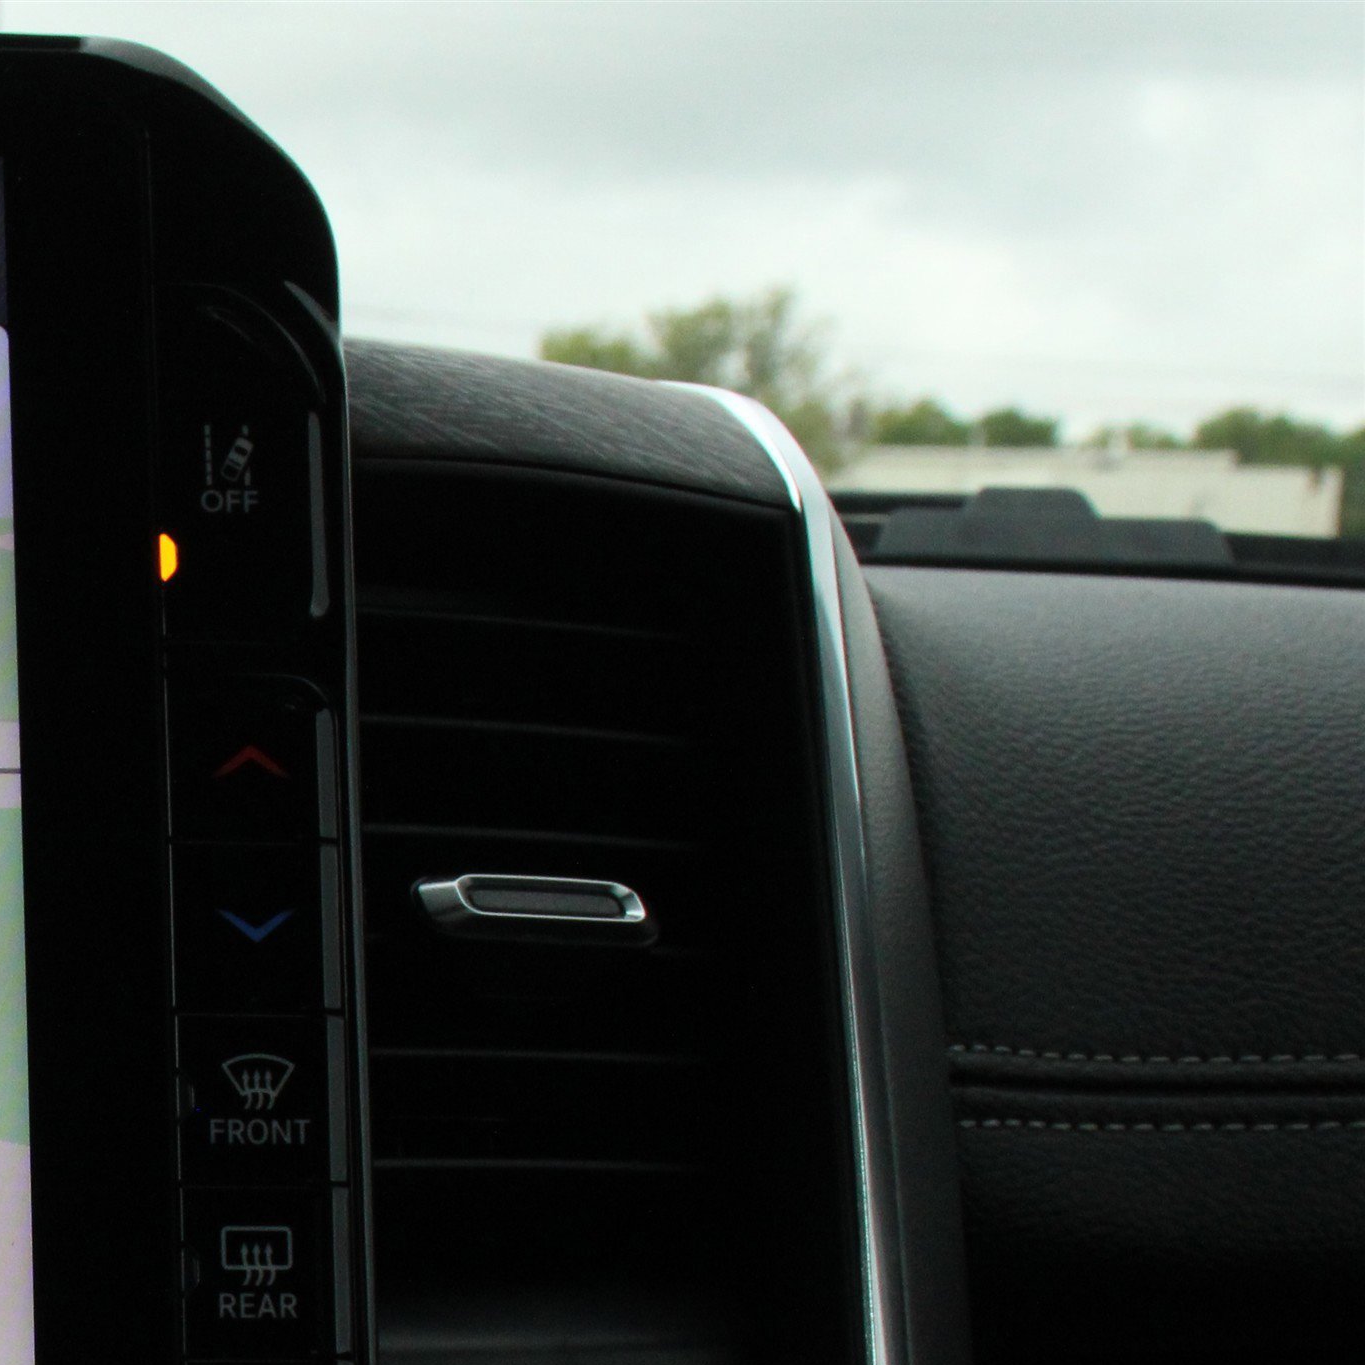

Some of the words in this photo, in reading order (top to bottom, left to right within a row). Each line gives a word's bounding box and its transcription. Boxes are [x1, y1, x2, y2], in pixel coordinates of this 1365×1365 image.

[200, 489, 258, 513] OFF
[210, 1118, 310, 1145] FRONT
[219, 1292, 297, 1319] REAR
